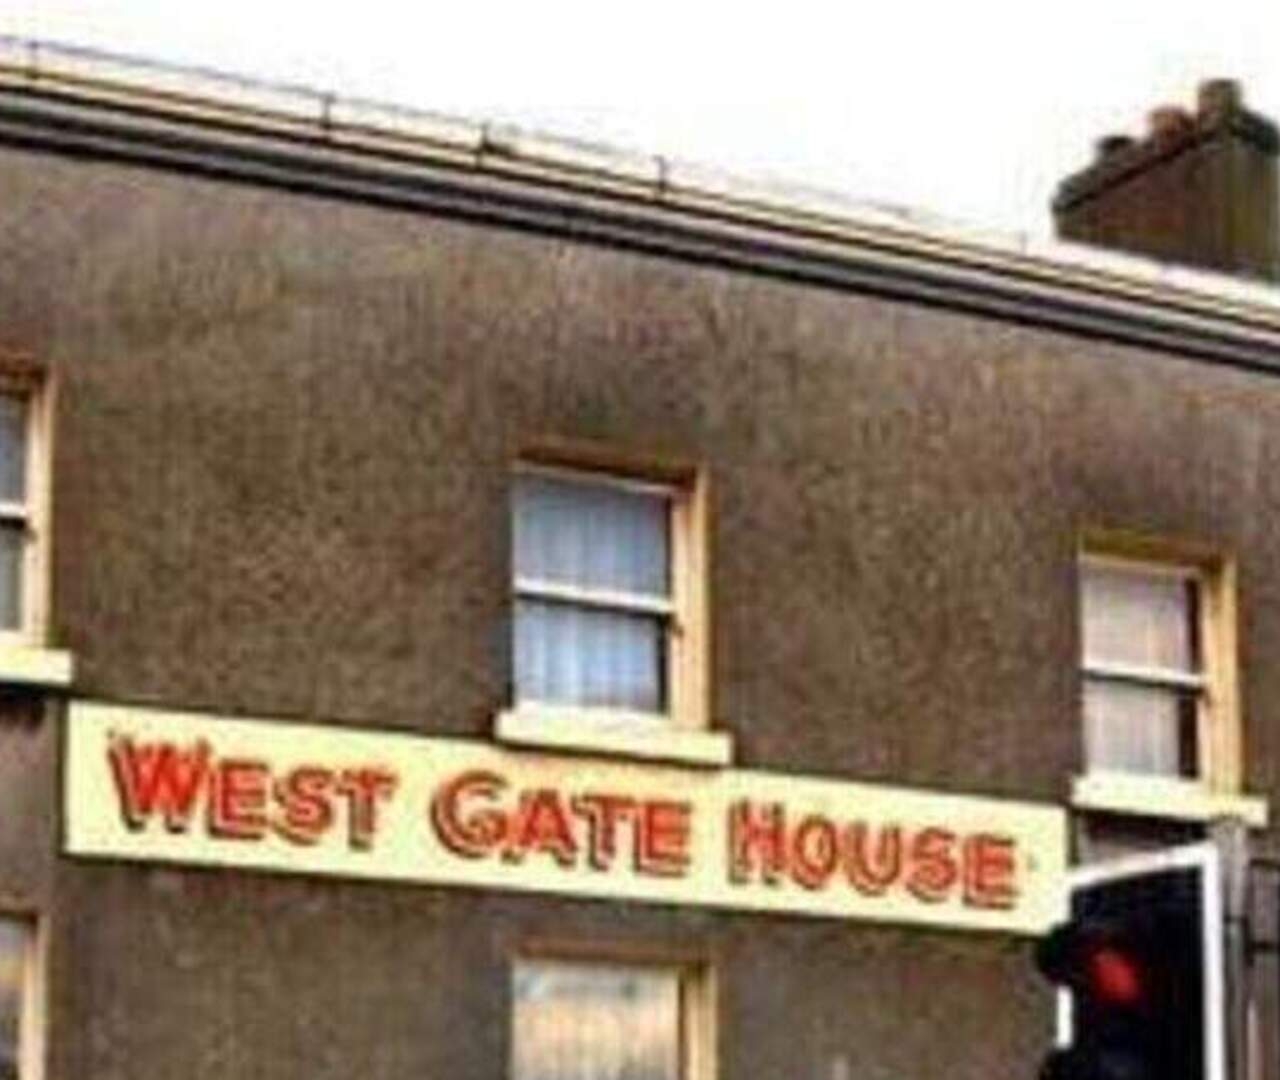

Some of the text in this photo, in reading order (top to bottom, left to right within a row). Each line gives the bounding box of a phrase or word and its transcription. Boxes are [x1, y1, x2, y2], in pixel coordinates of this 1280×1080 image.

[106, 731, 1020, 909] WEST GATE HOUSE
